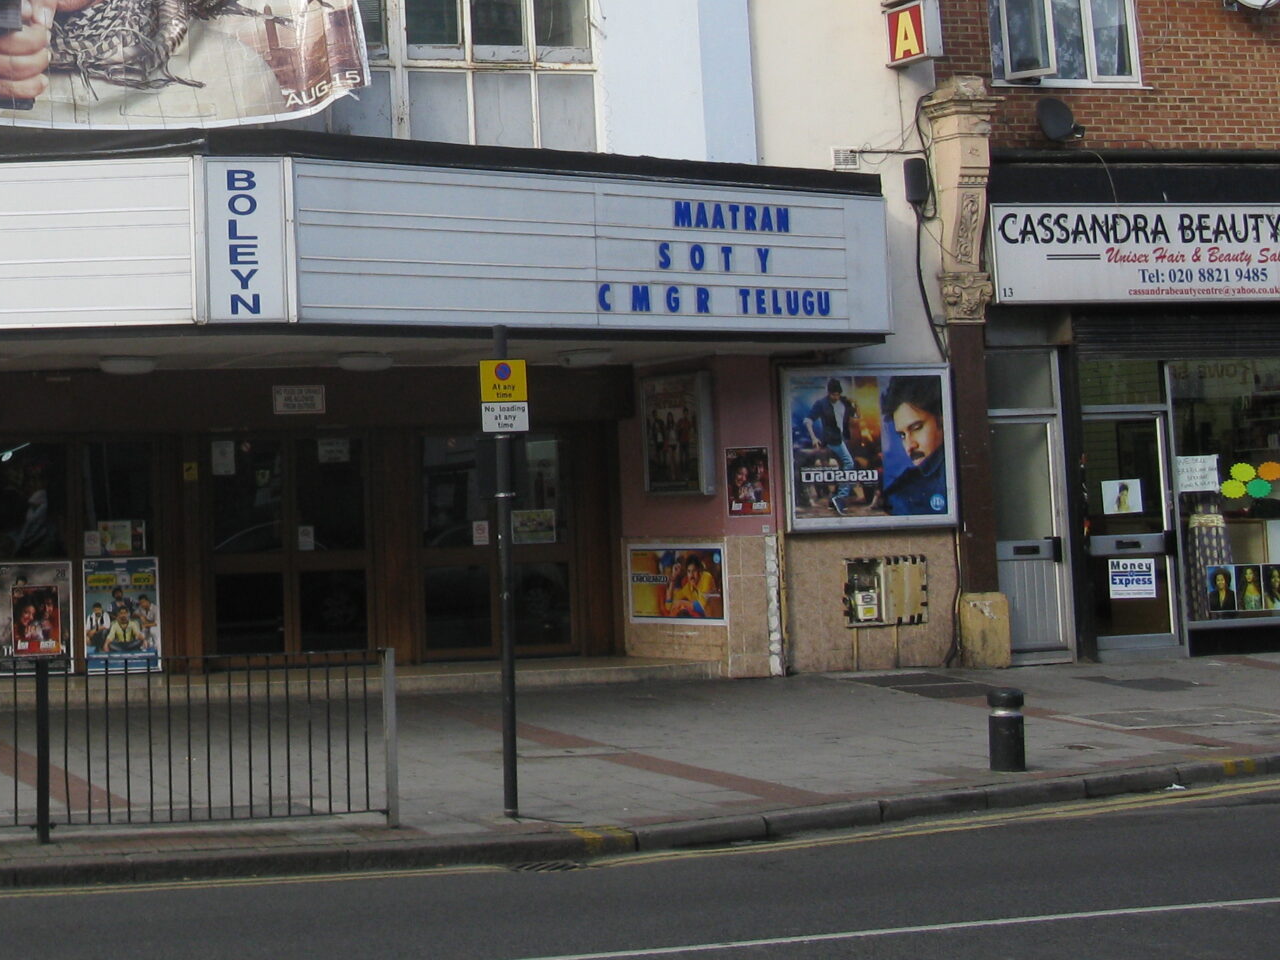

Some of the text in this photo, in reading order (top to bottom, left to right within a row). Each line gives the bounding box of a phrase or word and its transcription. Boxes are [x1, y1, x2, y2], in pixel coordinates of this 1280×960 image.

[286, 70, 361, 108] AUG 15
[673, 200, 790, 234] MAATRAN
[998, 212, 1280, 245] CASSANDRA BEAUTY
[225, 168, 263, 316] BOLEYN
[1105, 246, 1150, 264] Unisex
[1152, 246, 1186, 263] Hair
[1191, 246, 1202, 262] &
[1207, 246, 1252, 267] Beauty
[1138, 267, 1269, 283] Tel: 020 8821 9485
[1003, 287, 1014, 298] 13
[738, 287, 832, 318] TELUGU
[492, 383, 516, 392] At any
[499, 405, 526, 413] loading
[504, 414, 517, 422] any
[1110, 561, 1152, 573] Money
[1111, 576, 1153, 587] Express
